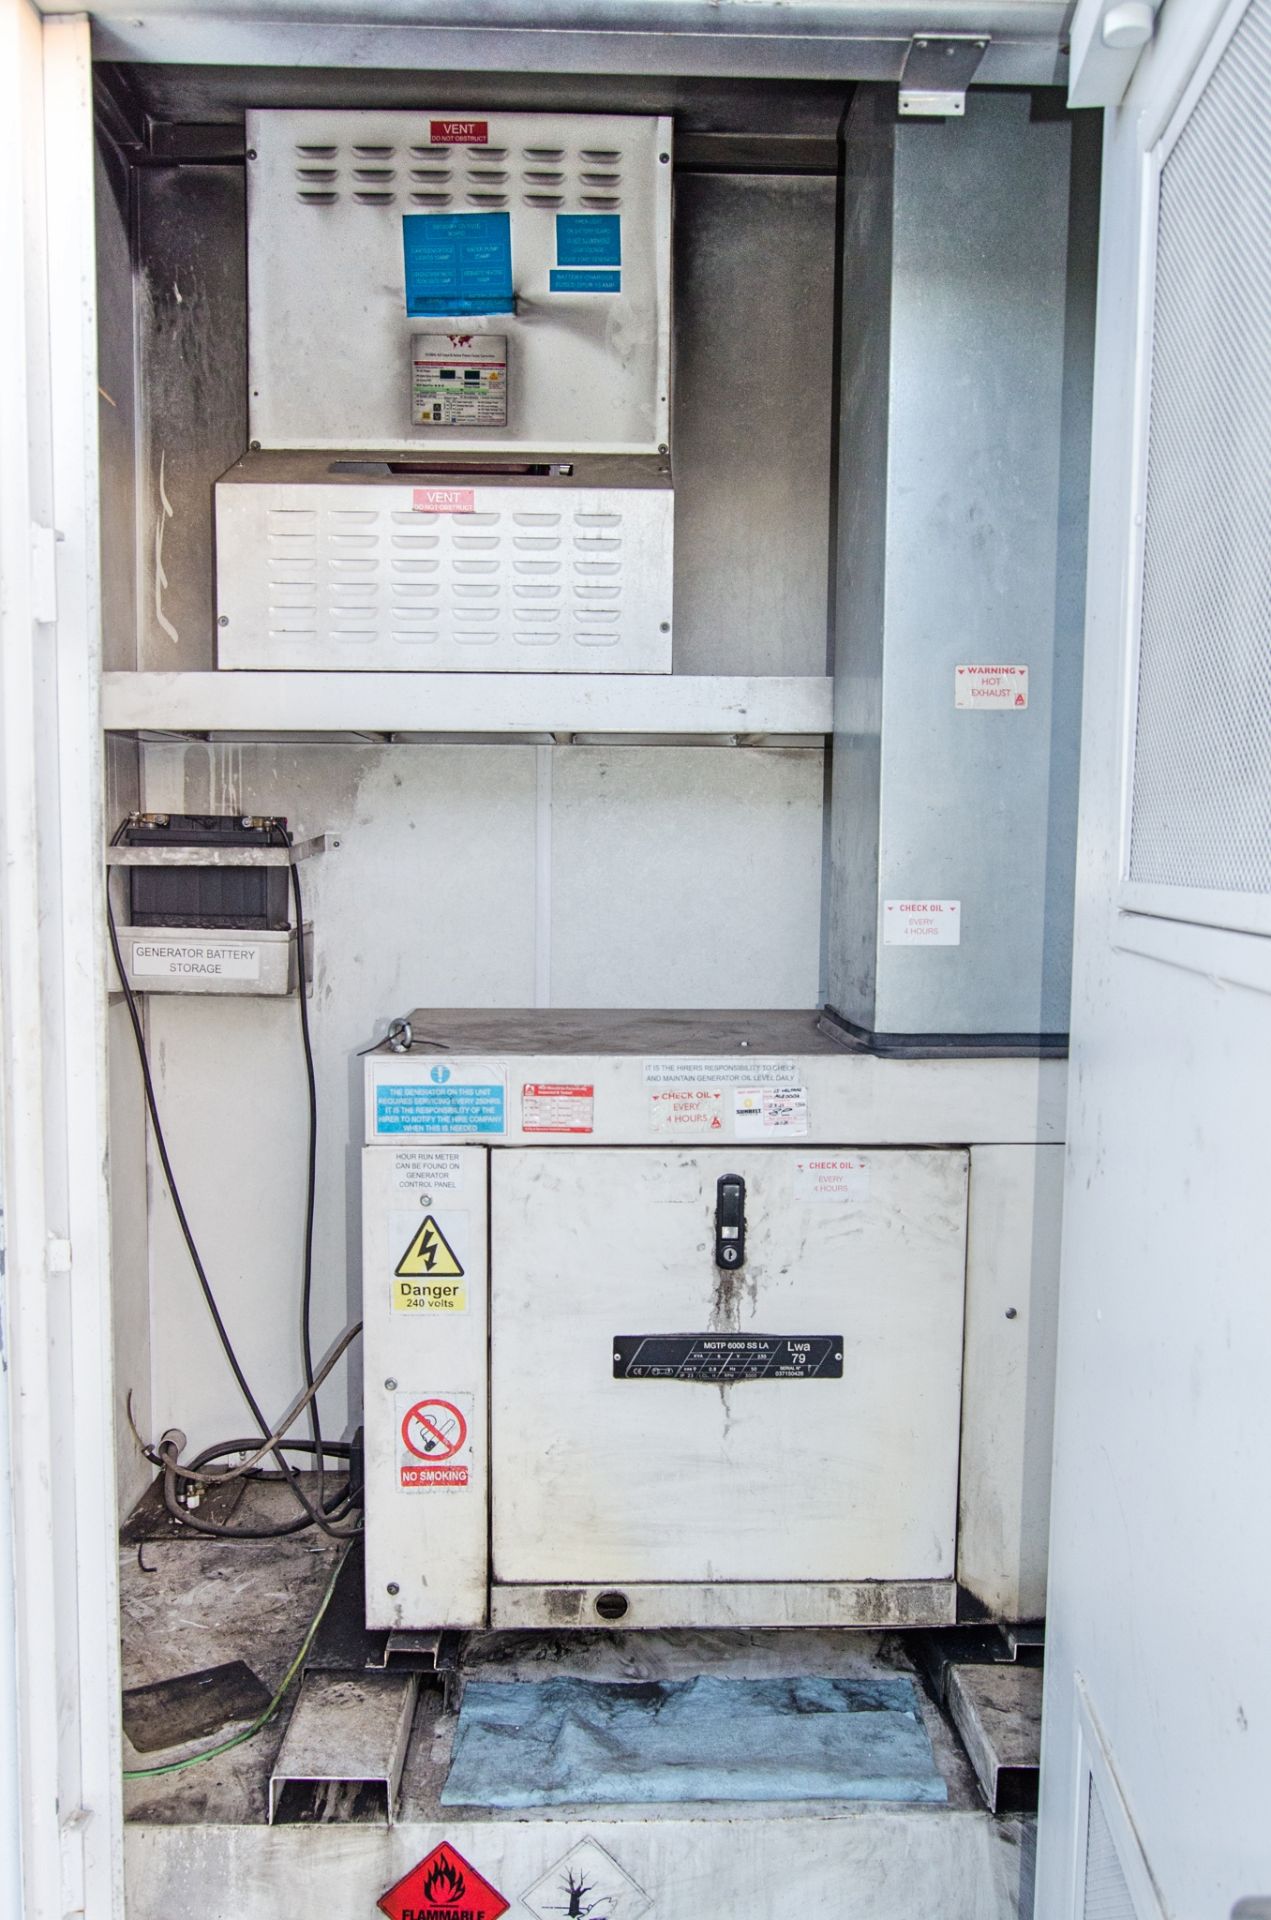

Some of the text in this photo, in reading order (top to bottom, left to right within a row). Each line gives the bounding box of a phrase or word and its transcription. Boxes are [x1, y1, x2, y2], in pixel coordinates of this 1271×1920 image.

[443, 123, 475, 134] VENT
[427, 492, 461, 503] VENT
[981, 678, 1001, 686] HOT
[971, 689, 1011, 697] EXHAUST
[899, 904, 944, 912] CHECK OIL
[908, 918, 934, 926] EVERY
[136, 947, 255, 960] GENERATOR BATTERY
[169, 963, 222, 974] STORAGE
[661, 1091, 712, 1100] CHECK OIL
[673, 1102, 700, 1111] EVERY
[666, 1114, 708, 1123] 4 HOURS
[818, 1175, 843, 1183] EVERY
[814, 1184, 848, 1192] 4 HOURS
[400, 1283, 459, 1299] Danger
[406, 1299, 454, 1308] 240 volts
[704, 1342, 727, 1350] MGTP
[787, 1341, 811, 1352] Lwa
[791, 1353, 806, 1364] 79
[402, 1471, 467, 1481] NO SMOKING
[402, 1909, 485, 1920] FLAMMABLE
